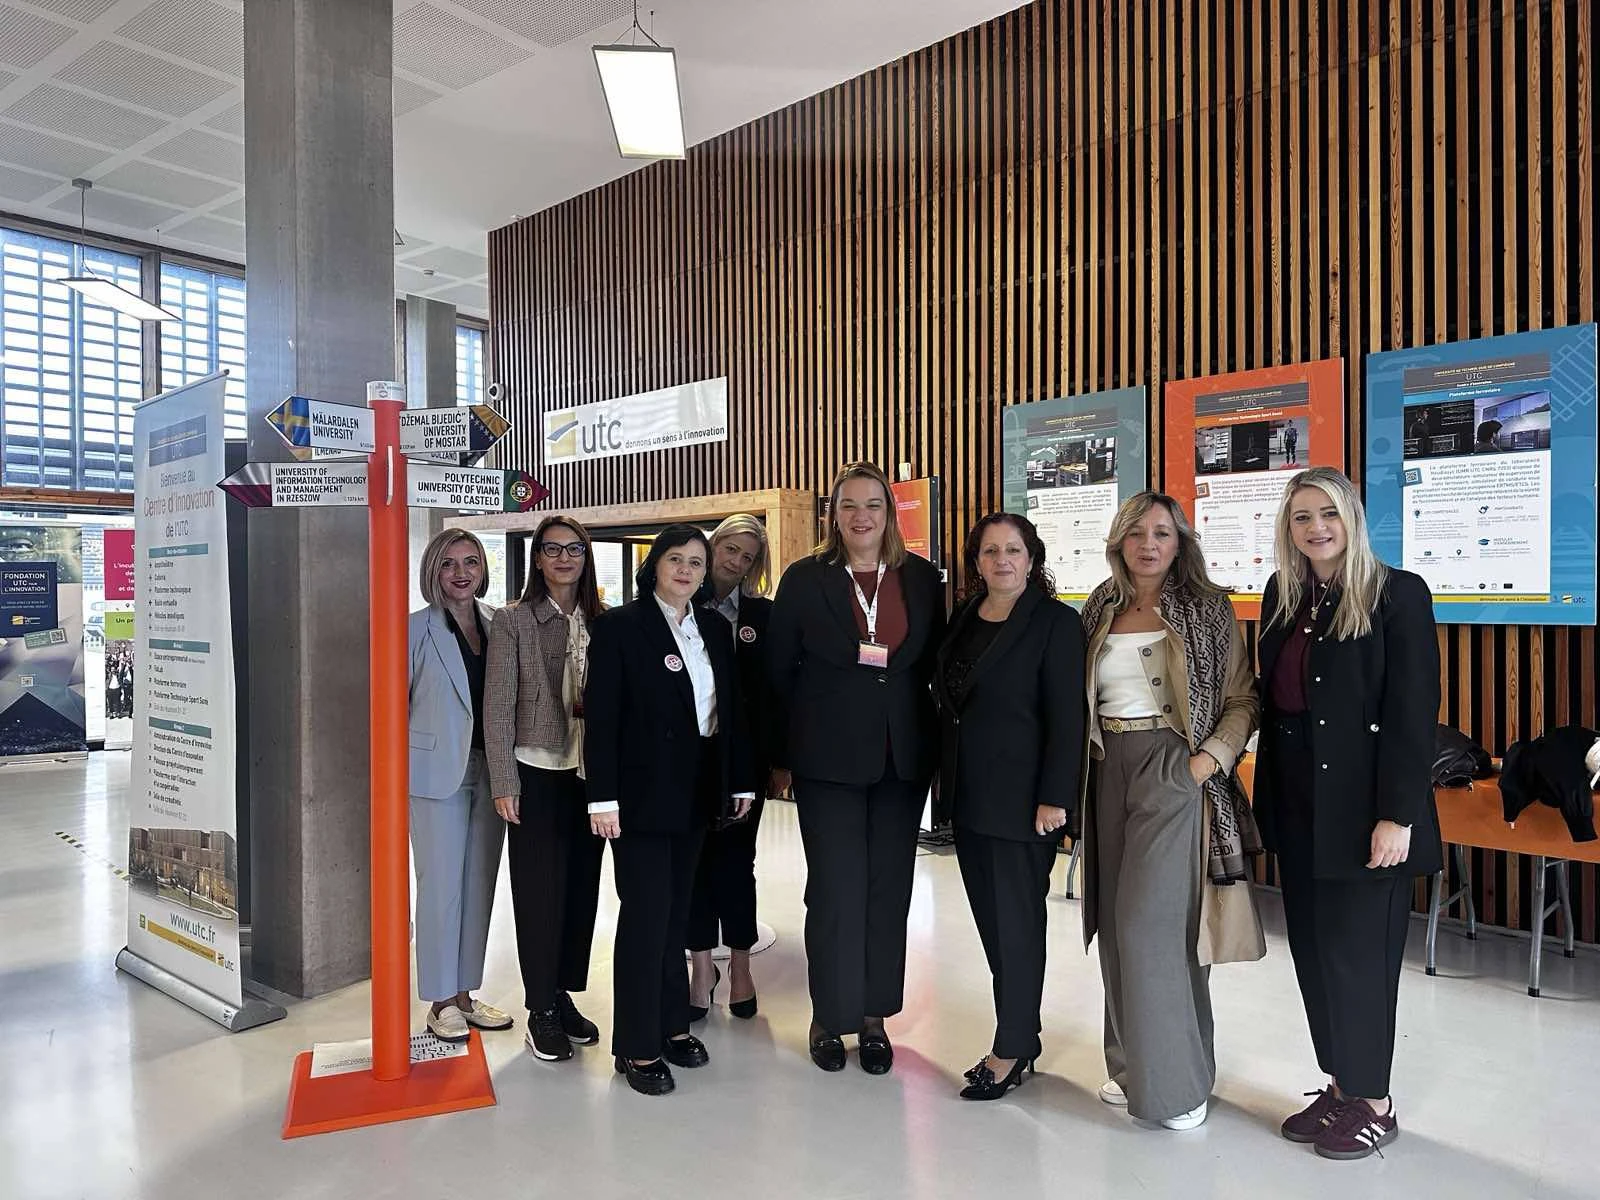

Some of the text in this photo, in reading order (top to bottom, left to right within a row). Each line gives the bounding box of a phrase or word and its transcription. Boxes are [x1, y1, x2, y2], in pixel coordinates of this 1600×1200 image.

[1466, 372, 1483, 380] UTC
[1243, 398, 1257, 406] UTC
[312, 411, 359, 429] MÄLARDALEN
[312, 426, 354, 441] UNIVERSITY
[423, 424, 467, 437] UNIVERSITY
[582, 414, 622, 454] utc
[652, 437, 661, 445] un
[662, 434, 677, 444] sens
[678, 431, 683, 441] à
[684, 426, 725, 440] l'innovation
[424, 436, 467, 449] OF MOSTAR
[187, 470, 195, 482] au
[275, 467, 328, 476] UNIVERSITY OF
[275, 476, 367, 485] INFORMATION TECHNOLOGY
[444, 472, 500, 486] POLYTECHNIC
[276, 485, 343, 494] AND MANAGEMENT
[417, 482, 500, 496] UNIVERSITY OF VIANA
[276, 494, 321, 503] IN RZESZOW
[450, 495, 500, 506] DO CASTELO
[144, 496, 166, 517] Centre
[165, 522, 174, 538] de
[170, 912, 216, 945] www.utc.fr
